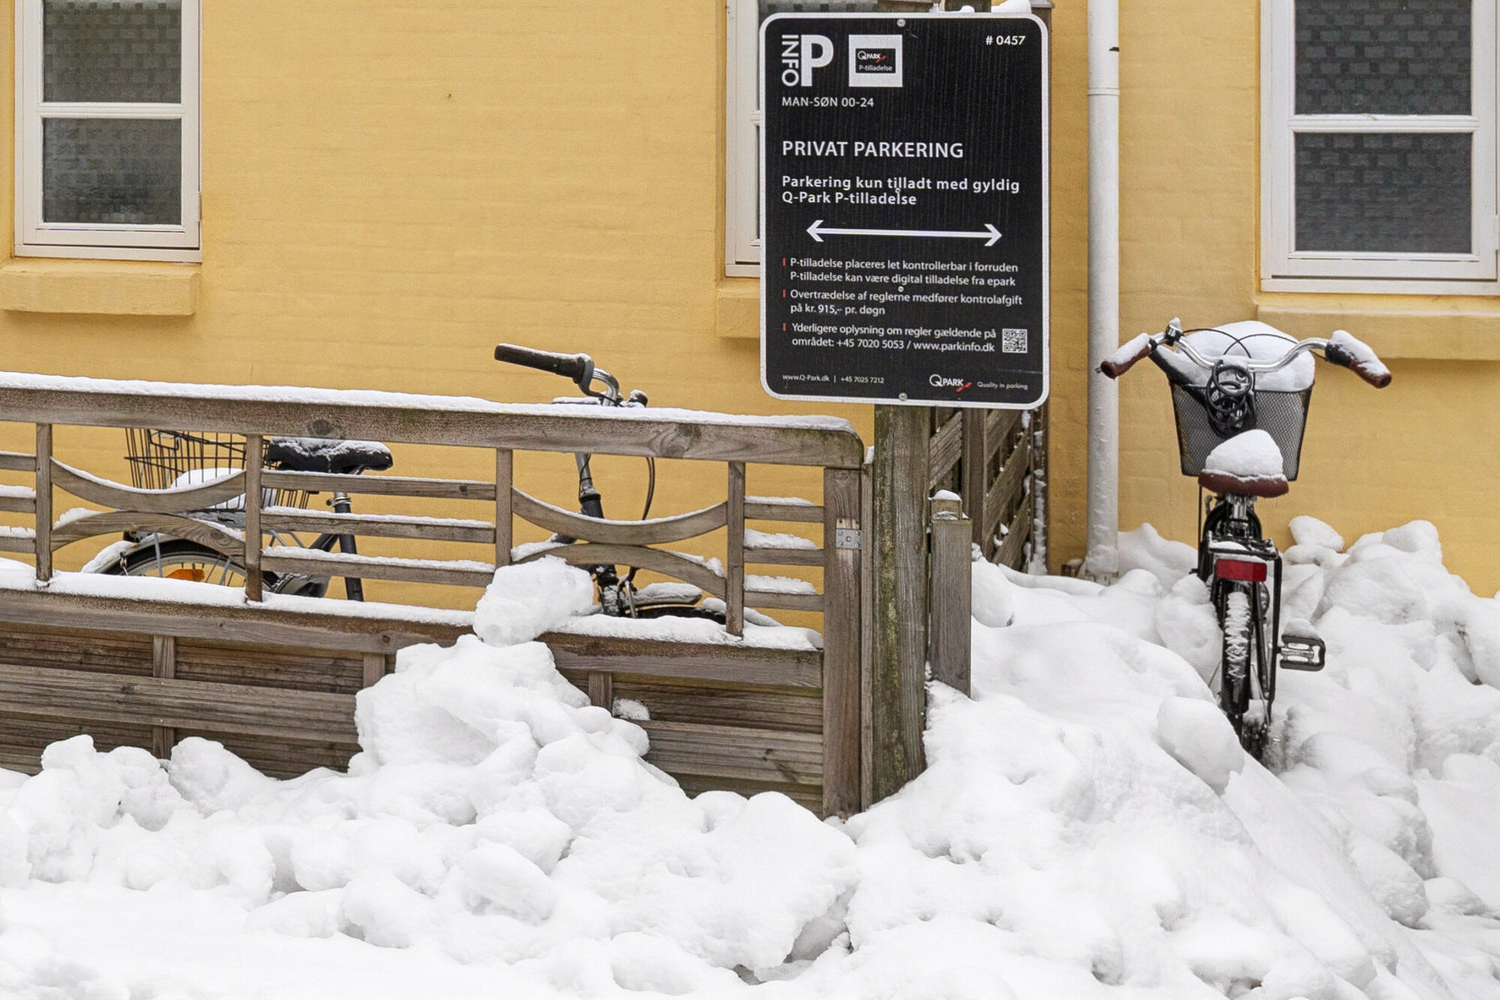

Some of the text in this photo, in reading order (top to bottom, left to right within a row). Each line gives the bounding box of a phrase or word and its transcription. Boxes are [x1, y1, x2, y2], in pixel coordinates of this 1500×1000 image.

[996, 35, 1026, 46] 0457
[781, 34, 799, 87] INFO
[800, 34, 834, 87] P
[781, 96, 875, 108] MAN-SØN 00-24
[781, 140, 964, 158] PRIVAT PARKERING
[781, 176, 1020, 194] Parkering kun tilladt med gyldig
[781, 191, 917, 205] Q-Park P-tilladelse
[790, 257, 1018, 272] P-tilladelse placeres let kontrollerbar i forruden
[790, 271, 1016, 288] P-tilladelse kan være digital tilladelse fra epark
[790, 289, 1023, 307] Overtrædelse af reglerne medfører kontrolafgift
[790, 303, 803, 314] på
[805, 303, 816, 313] kr.
[845, 306, 857, 316] pr.
[859, 305, 886, 317] døgn
[792, 322, 997, 340] Yderligere oplysning om regler gældende på
[792, 336, 834, 347] området:
[836, 338, 855, 347] +45
[857, 339, 880, 348] 7020
[881, 339, 904, 349] 5053
[913, 342, 995, 352] www.parkinfo.dk
[781, 374, 830, 382] www.Q-Park.dk
[840, 375, 852, 383] +45
[854, 376, 869, 384] 7025
[870, 376, 885, 384] 7212
[976, 381, 998, 389] Quality
[1005, 382, 1028, 390] parking
